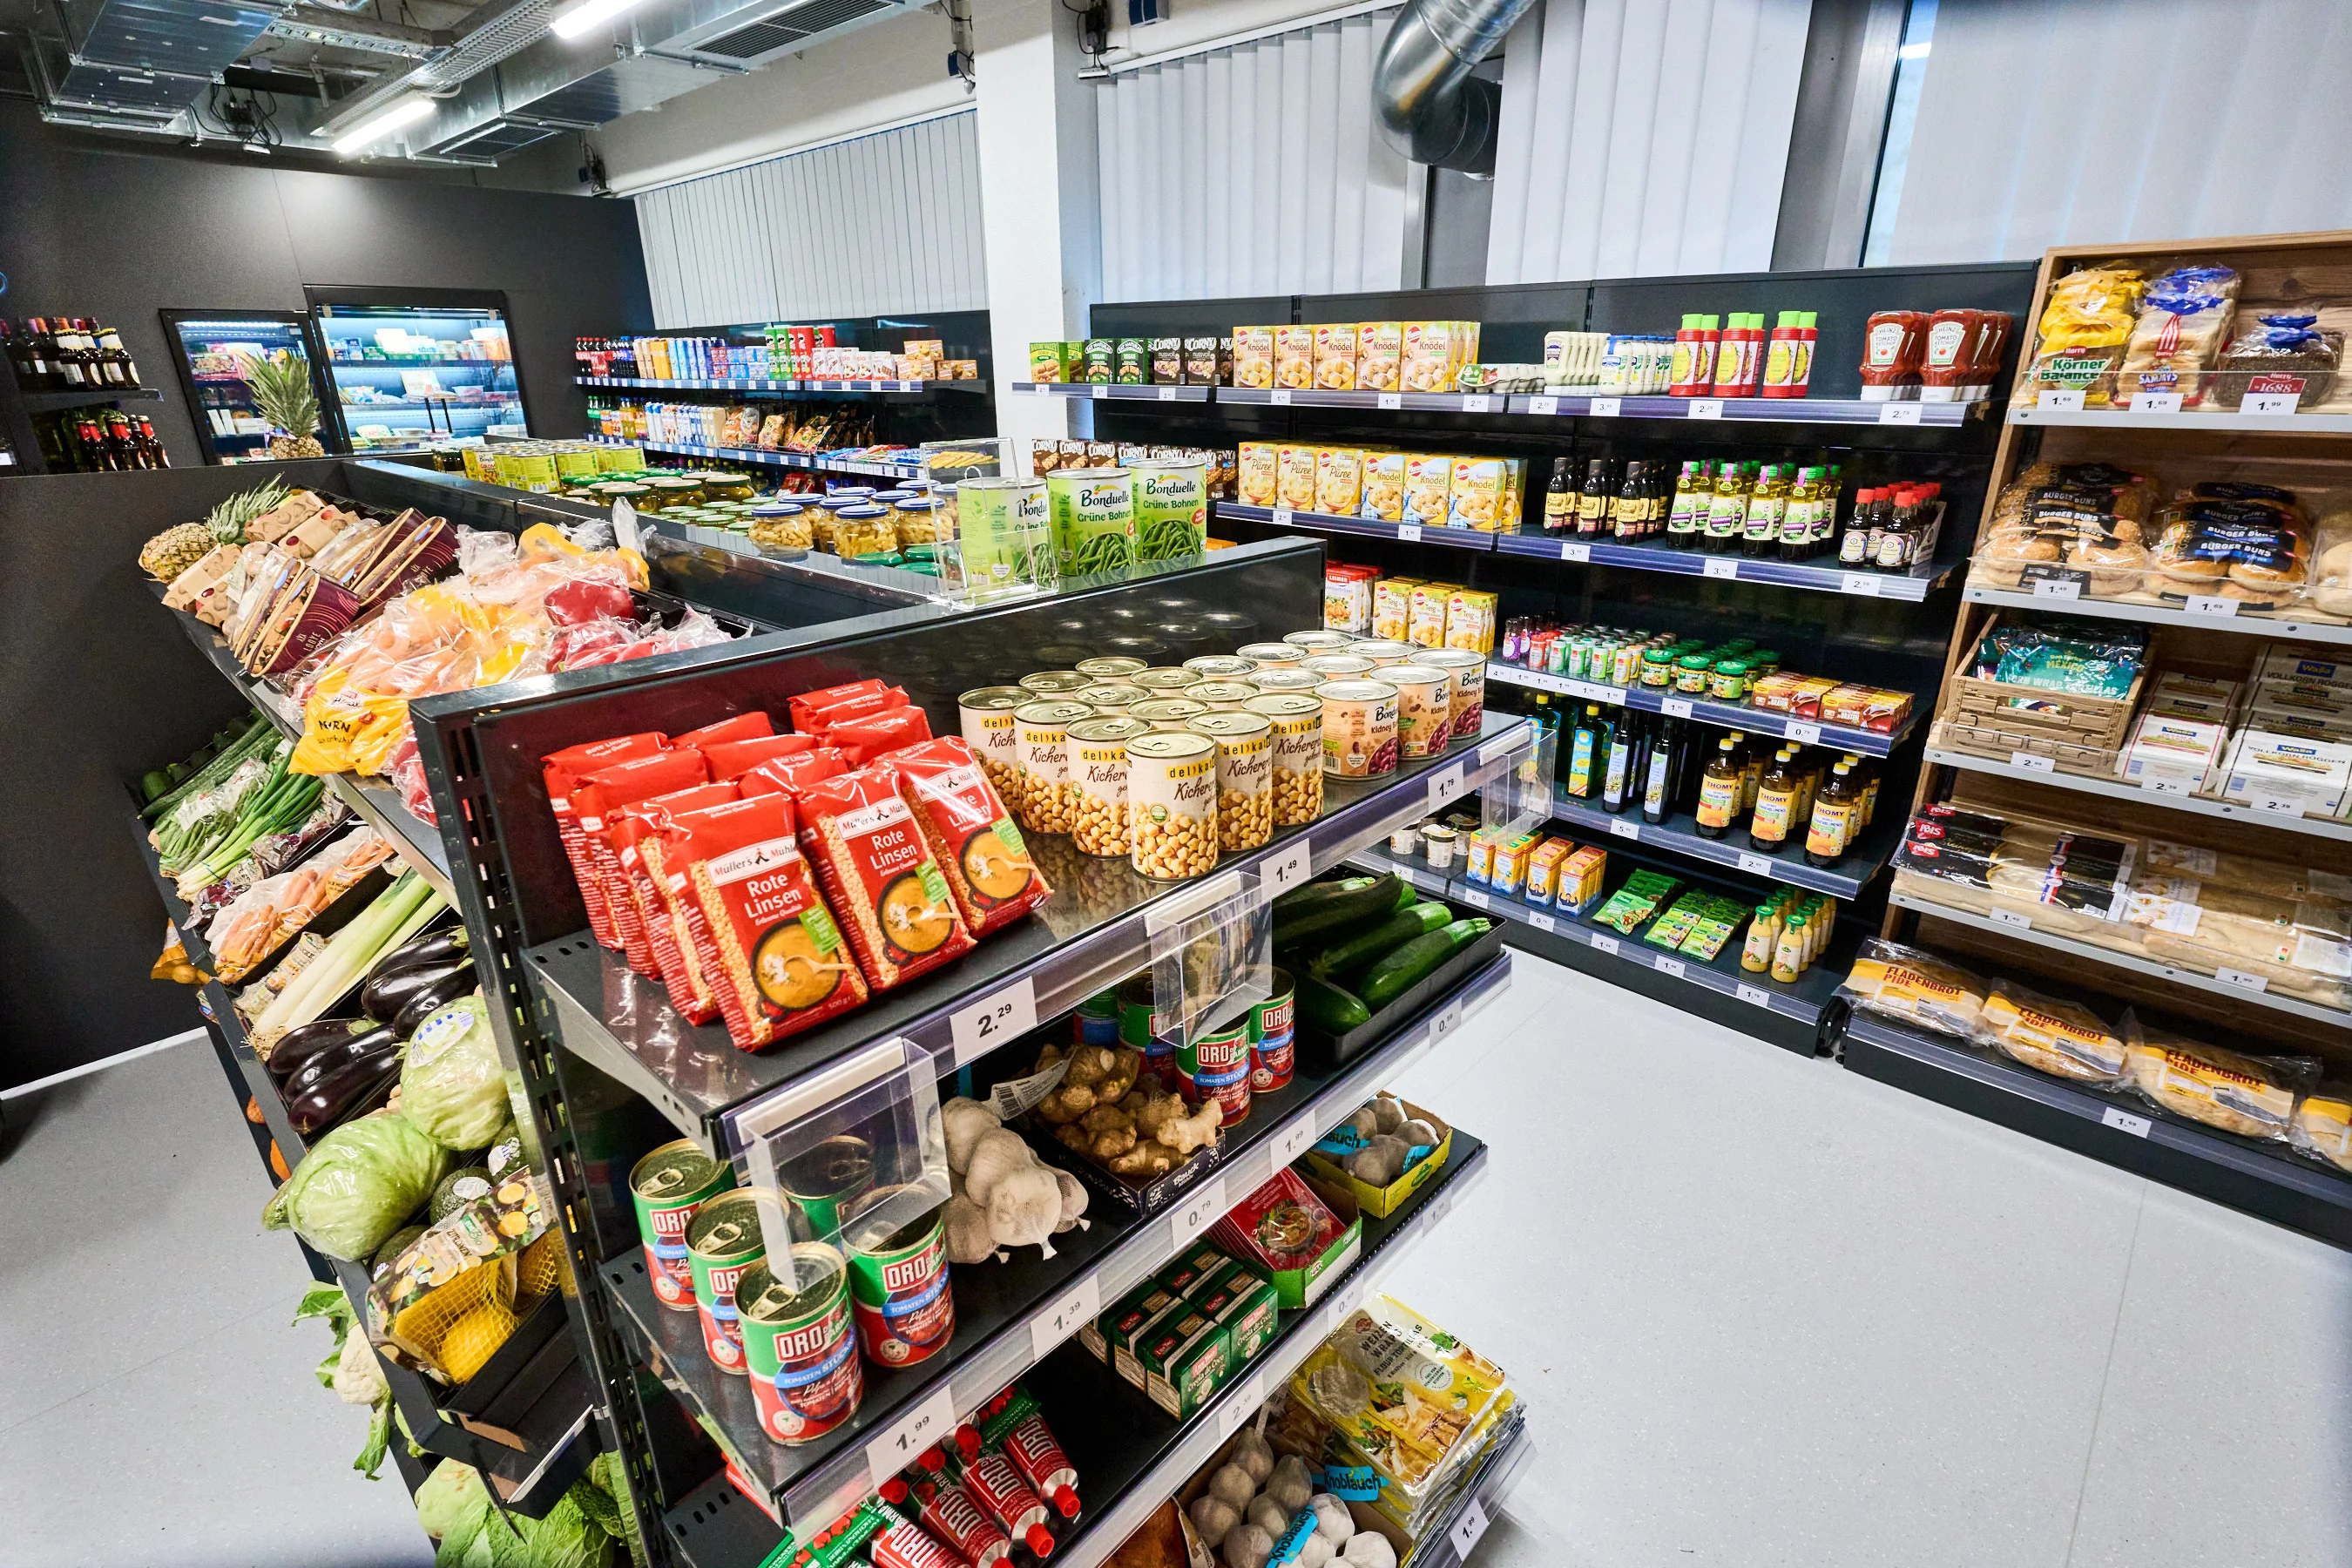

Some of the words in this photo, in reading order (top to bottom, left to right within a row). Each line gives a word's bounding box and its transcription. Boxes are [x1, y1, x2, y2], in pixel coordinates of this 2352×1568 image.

[1153, 338, 1181, 351] CORNY
[1188, 337, 1217, 351] CORNY
[1247, 343, 1270, 352] Knödel
[1288, 342, 1309, 351] Knödel
[1328, 342, 1353, 351] Knödel
[1373, 341, 1399, 350] Knödel
[1419, 341, 1446, 350] Knödel
[2052, 358, 2106, 370] Körner
[2260, 382, 2292, 394] 1688
[2258, 402, 2281, 410] 1.99
[1032, 439, 1058, 452] CORNY
[1059, 441, 1085, 454] CORNY
[1088, 443, 1116, 458] CORNY
[1118, 446, 1147, 459] CORNY
[1251, 459, 1273, 471] Püree
[1290, 463, 1312, 475] Püree
[1329, 465, 1352, 479] Püree
[1377, 471, 1401, 483] Knödel
[1420, 475, 1446, 485] Knödel
[1468, 479, 1496, 490] Knödel
[1146, 477, 1196, 496] Bonduelle
[1080, 488, 1129, 508] Bonduelle
[1143, 498, 1169, 510] Grüne
[1172, 497, 1199, 509] Bohnen
[2042, 491, 2073, 501] BURGER
[1078, 511, 1106, 523] Grüne
[2073, 512, 2099, 522] BUNS
[2207, 526, 2245, 537] BURGER
[2200, 542, 2241, 551] BURGER
[2244, 545, 2272, 558] BUNS
[1328, 575, 1349, 584] LEIMER
[1387, 598, 1398, 608] Teig
[1425, 603, 1436, 613] Teig
[1463, 610, 1474, 620] Teig
[2047, 659, 2085, 672] MÉXICO
[2268, 672, 2316, 685] VOLLKORN
[1456, 688, 1477, 699] Kidney
[1370, 724, 1392, 734] Kidney
[1030, 746, 1067, 764] Kicher
[2247, 745, 2301, 760] VOLLKORN
[2304, 755, 2346, 765] ROGGEN
[1086, 763, 1127, 782] Kicher
[1439, 778, 1455, 797] 1.79
[1706, 781, 1734, 790] THOMY
[1760, 793, 1788, 803] THOMY
[2268, 801, 2291, 810] 2.39
[1816, 807, 1845, 818] THOMY
[1919, 822, 1941, 836] IBIS
[871, 829, 905, 850] Rote
[1913, 843, 1937, 855] IBIS
[869, 844, 917, 870] Linsen
[713, 858, 754, 876] Müller's
[1276, 859, 1298, 882] 1.49
[746, 873, 788, 897] Rote
[744, 889, 802, 919] Linsen
[1882, 973, 1912, 989] PIDE
[1885, 965, 1962, 997] FLADENBROT
[977, 1003, 1013, 1038] 2.29
[1265, 1007, 1288, 1028] ORO
[2019, 1007, 2105, 1043] FLADENBROT
[1200, 1044, 1229, 1064] ORO
[2166, 1049, 2264, 1089] FLADENBROT
[1285, 1129, 1303, 1153] 1.99
[653, 1209, 692, 1233] ORO
[1188, 1200, 1212, 1227] 0.79
[469, 1230, 483, 1246] Bio
[887, 1256, 926, 1288] ORO
[713, 1270, 742, 1293] OR
[891, 1299, 924, 1314] TOMATEN
[1053, 1301, 1082, 1331] 1.39
[779, 1325, 823, 1358] ORO
[1361, 1321, 1393, 1352] WEIZEN
[1374, 1357, 1396, 1376] FLOUR
[785, 1369, 821, 1384] TOMATEN
[1232, 1393, 1252, 1420] 2.39
[896, 1415, 929, 1452] 1.99
[1016, 1423, 1055, 1461] ORO
[978, 1458, 1022, 1500] ORO
[1323, 1468, 1382, 1491] Knoblauch
[939, 1490, 983, 1540] ORO
[1269, 1505, 1315, 1562] Knoblauch
[1462, 1516, 1476, 1540] 1.99
[890, 1524, 940, 1567] ORO
